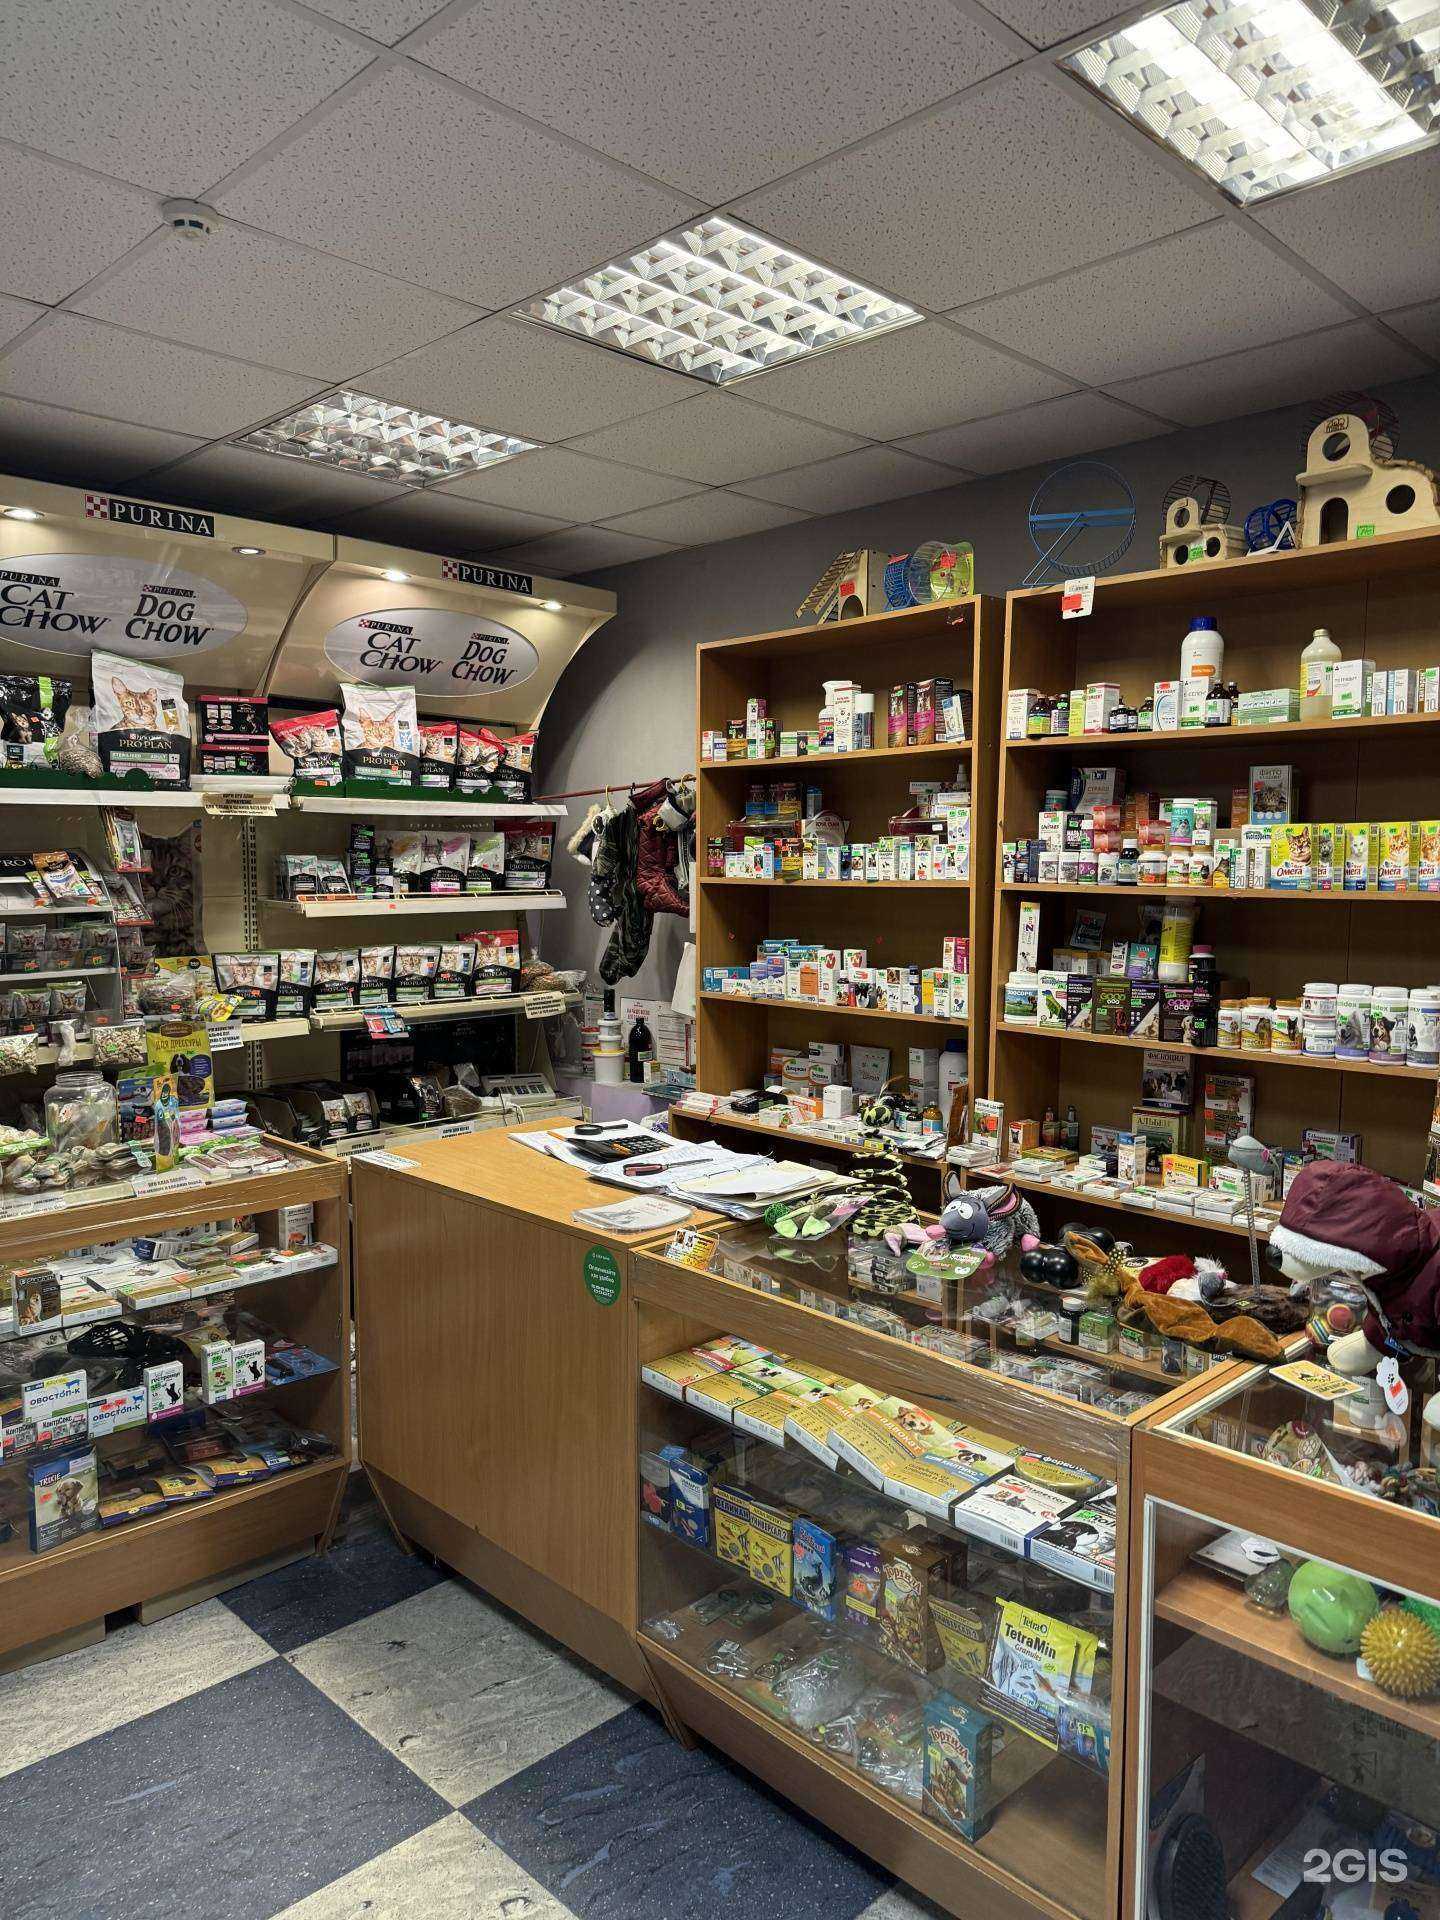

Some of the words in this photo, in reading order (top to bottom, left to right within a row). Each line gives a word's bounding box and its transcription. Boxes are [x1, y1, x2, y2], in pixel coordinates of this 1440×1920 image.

[112, 502, 212, 536] PURINA
[0, 570, 57, 587] PURINA
[462, 565, 531, 593] PURINA
[1, 584, 74, 611] CAT
[153, 586, 194, 599] PURINA
[0, 605, 109, 635] CHOW
[134, 594, 195, 622] DOG
[125, 618, 209, 646] CHOW
[370, 620, 413, 635] PURINA
[479, 633, 509, 644] PURINA
[367, 632, 421, 654] CAT
[461, 640, 507, 664] DOG
[359, 649, 441, 675] CHOW
[452, 660, 515, 685] CHOW
[1022, 1615, 1039, 1631] Tetra
[1004, 1622, 1056, 1660] TetraMin
[1015, 1643, 1041, 1662] Granules
